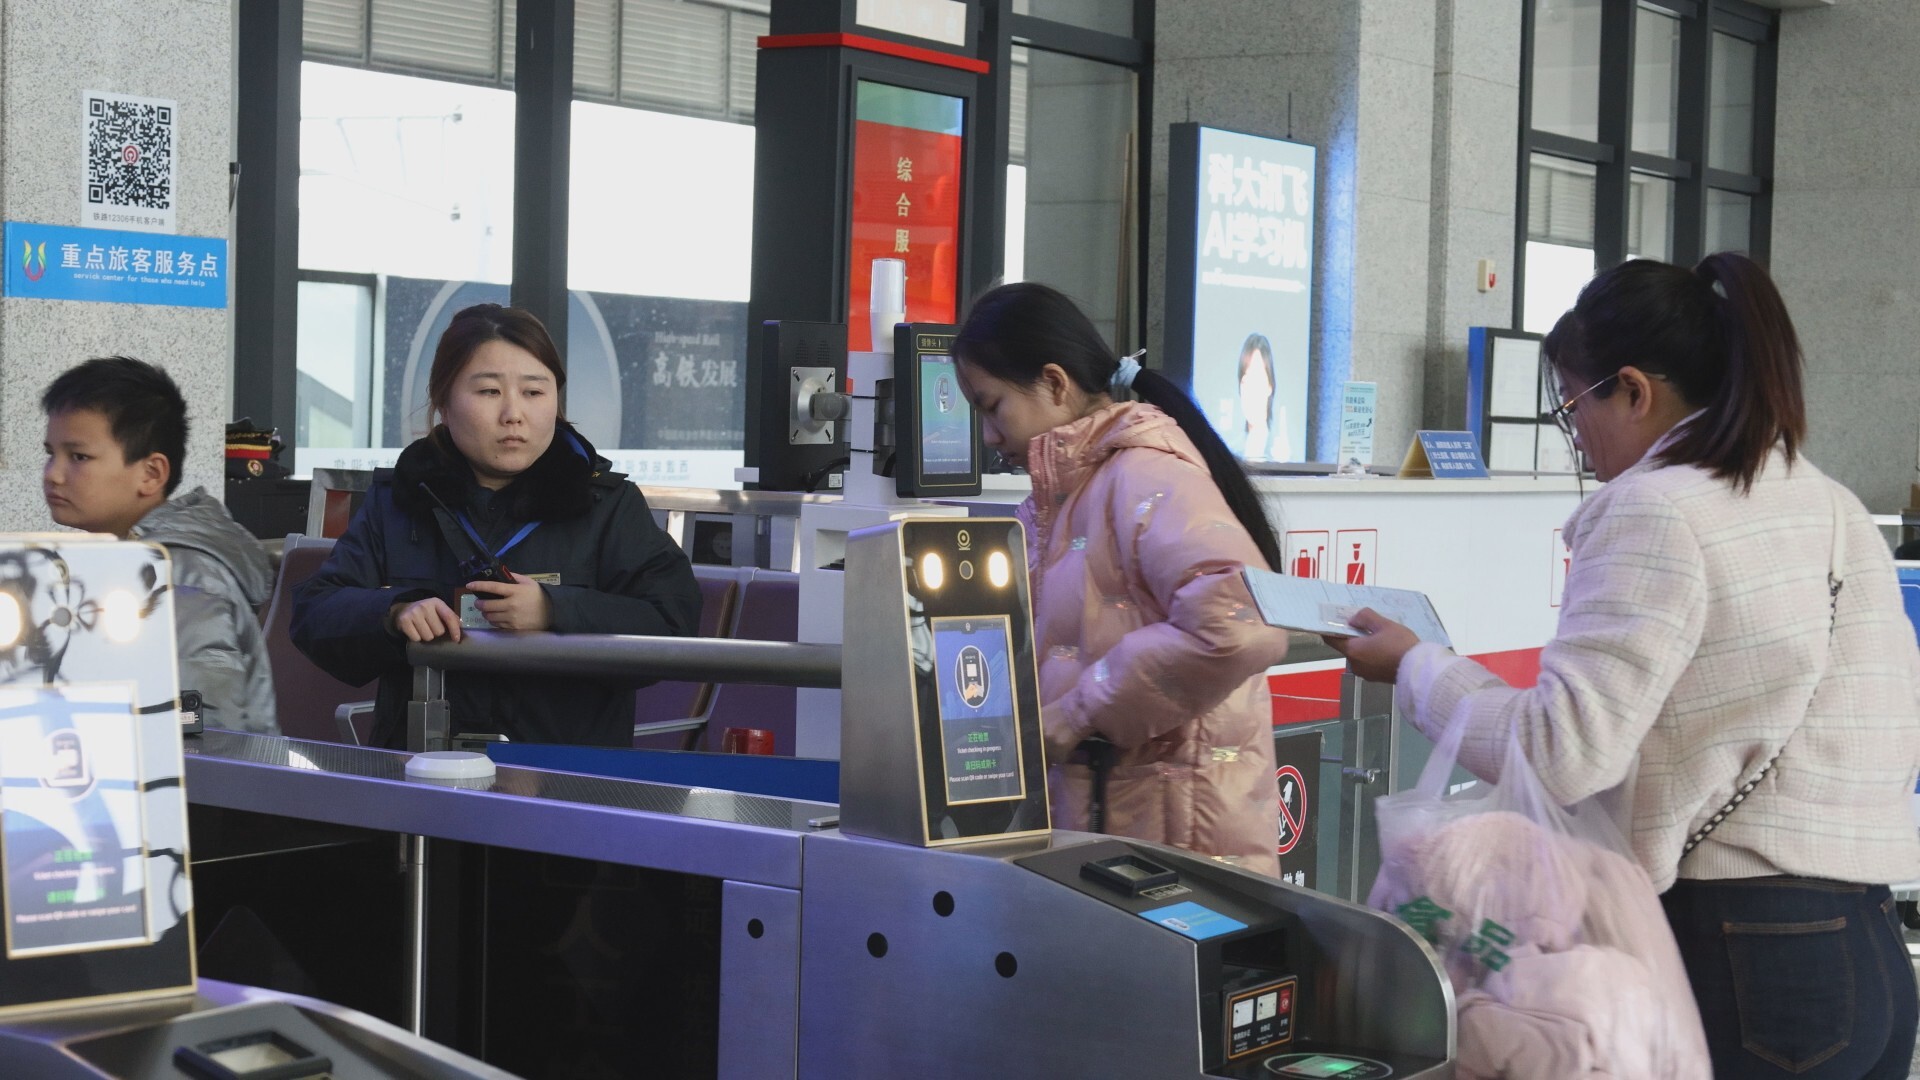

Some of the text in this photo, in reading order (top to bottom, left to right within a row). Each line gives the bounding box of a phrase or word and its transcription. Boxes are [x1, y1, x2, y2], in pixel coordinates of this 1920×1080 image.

[93, 212, 165, 226] 铁路12306手机客户端
[893, 157, 912, 284] 综合服
[60, 243, 218, 278] 重点旅客服务点
[127, 274, 137, 282] for
[140, 276, 159, 284] those
[190, 279, 205, 288] help
[653, 351, 737, 388] 高铁发展
